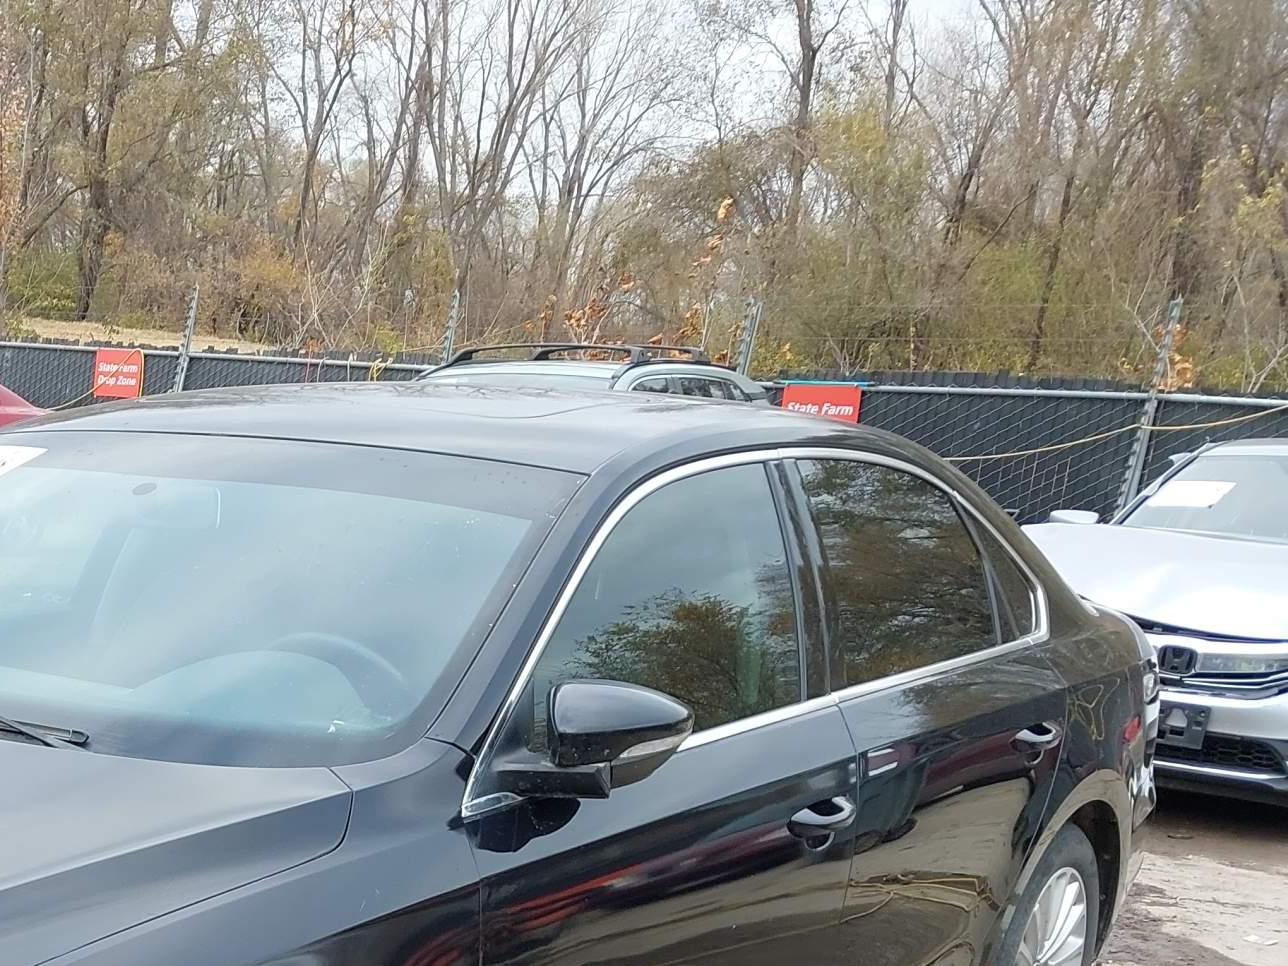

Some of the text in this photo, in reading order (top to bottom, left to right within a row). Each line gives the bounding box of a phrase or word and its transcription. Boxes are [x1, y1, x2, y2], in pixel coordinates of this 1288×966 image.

[116, 375, 137, 386] Zone
[787, 402, 854, 416] State Farm
